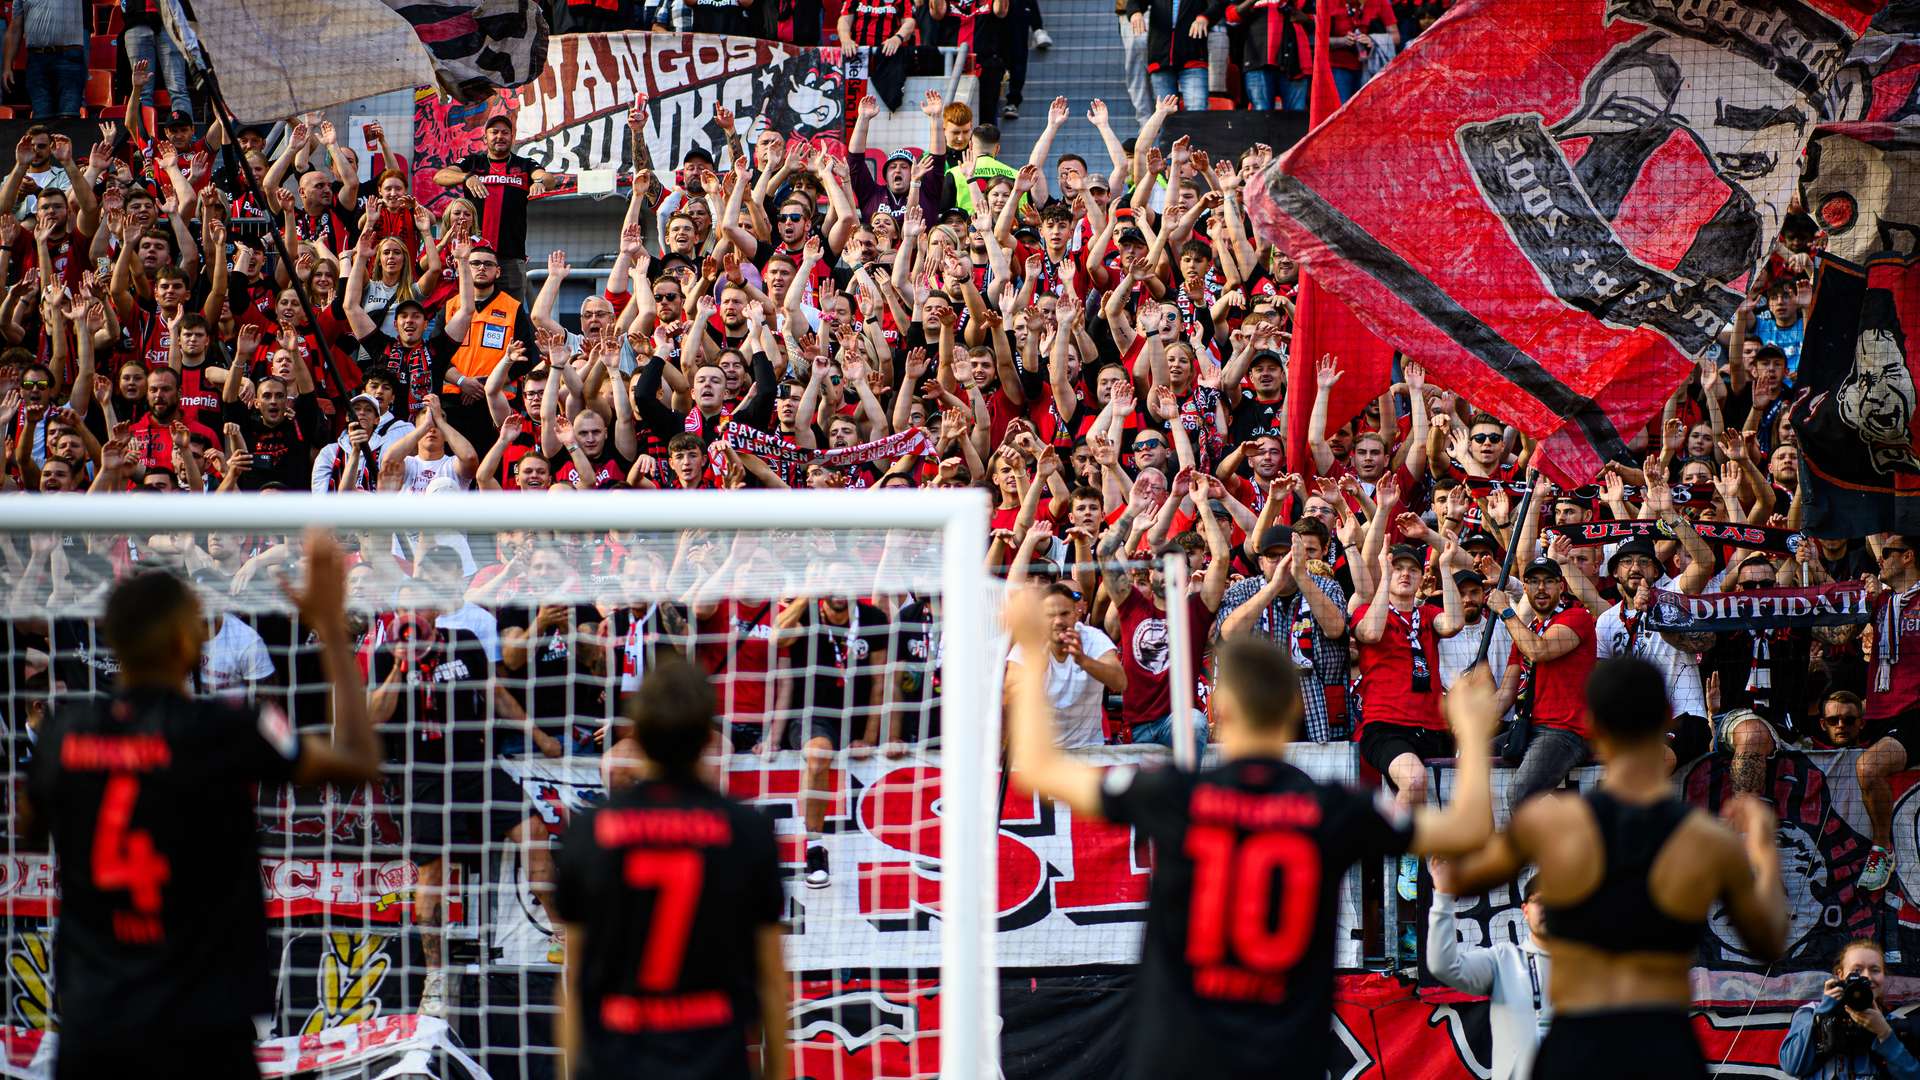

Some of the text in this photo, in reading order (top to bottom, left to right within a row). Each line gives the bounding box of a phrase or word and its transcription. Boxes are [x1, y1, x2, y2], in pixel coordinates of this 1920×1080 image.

[476, 174, 524, 185] armenia
[878, 203, 907, 217] Barme
[486, 331, 502, 341] 663
[728, 434, 808, 462] EVERKUSEN
[1689, 588, 1870, 621] DIFFIDATI
[91, 776, 171, 913] 4
[1185, 823, 1322, 976] 10
[623, 850, 704, 991] 7
